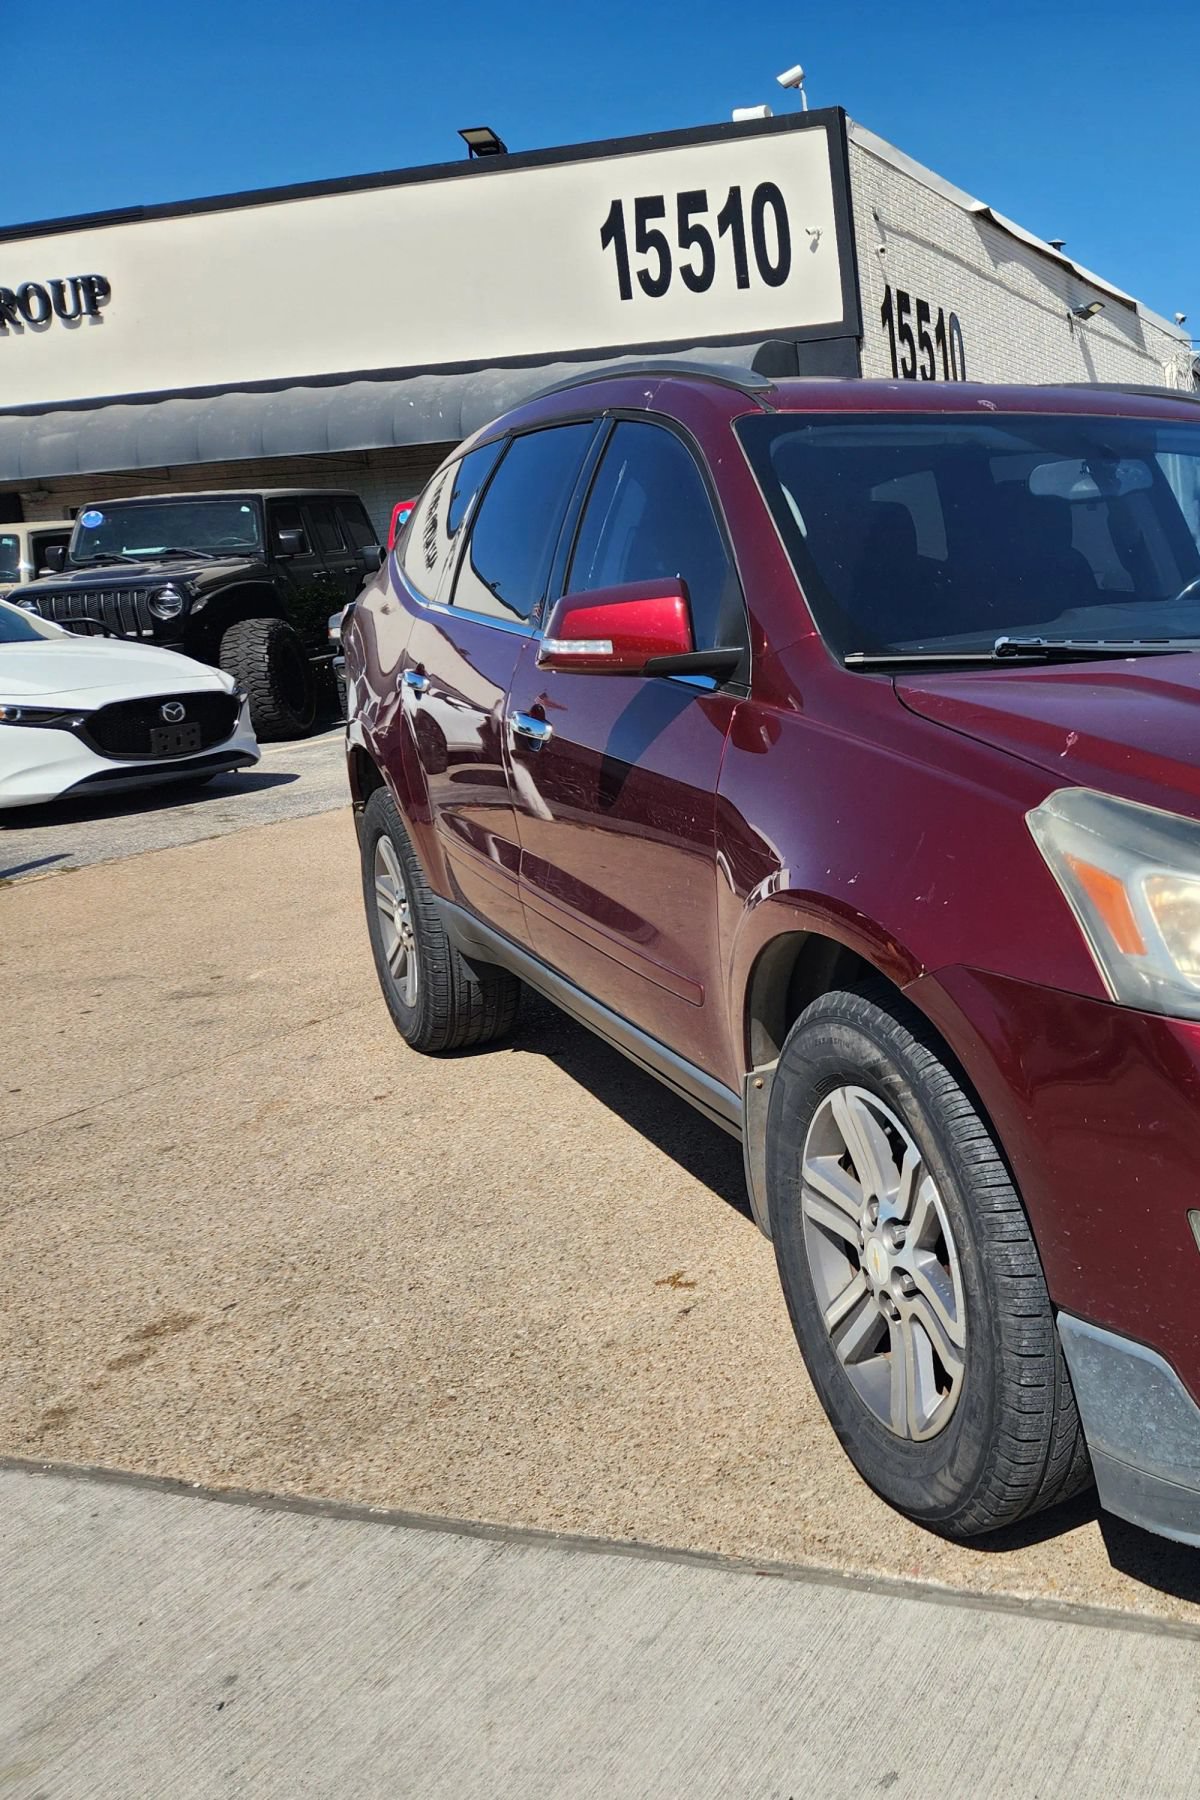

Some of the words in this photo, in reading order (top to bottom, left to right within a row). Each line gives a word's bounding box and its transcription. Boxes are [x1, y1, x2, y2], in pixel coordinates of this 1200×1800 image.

[600, 181, 792, 301] 15510
[0, 274, 112, 327] ROUP
[880, 284, 967, 381] 15510
